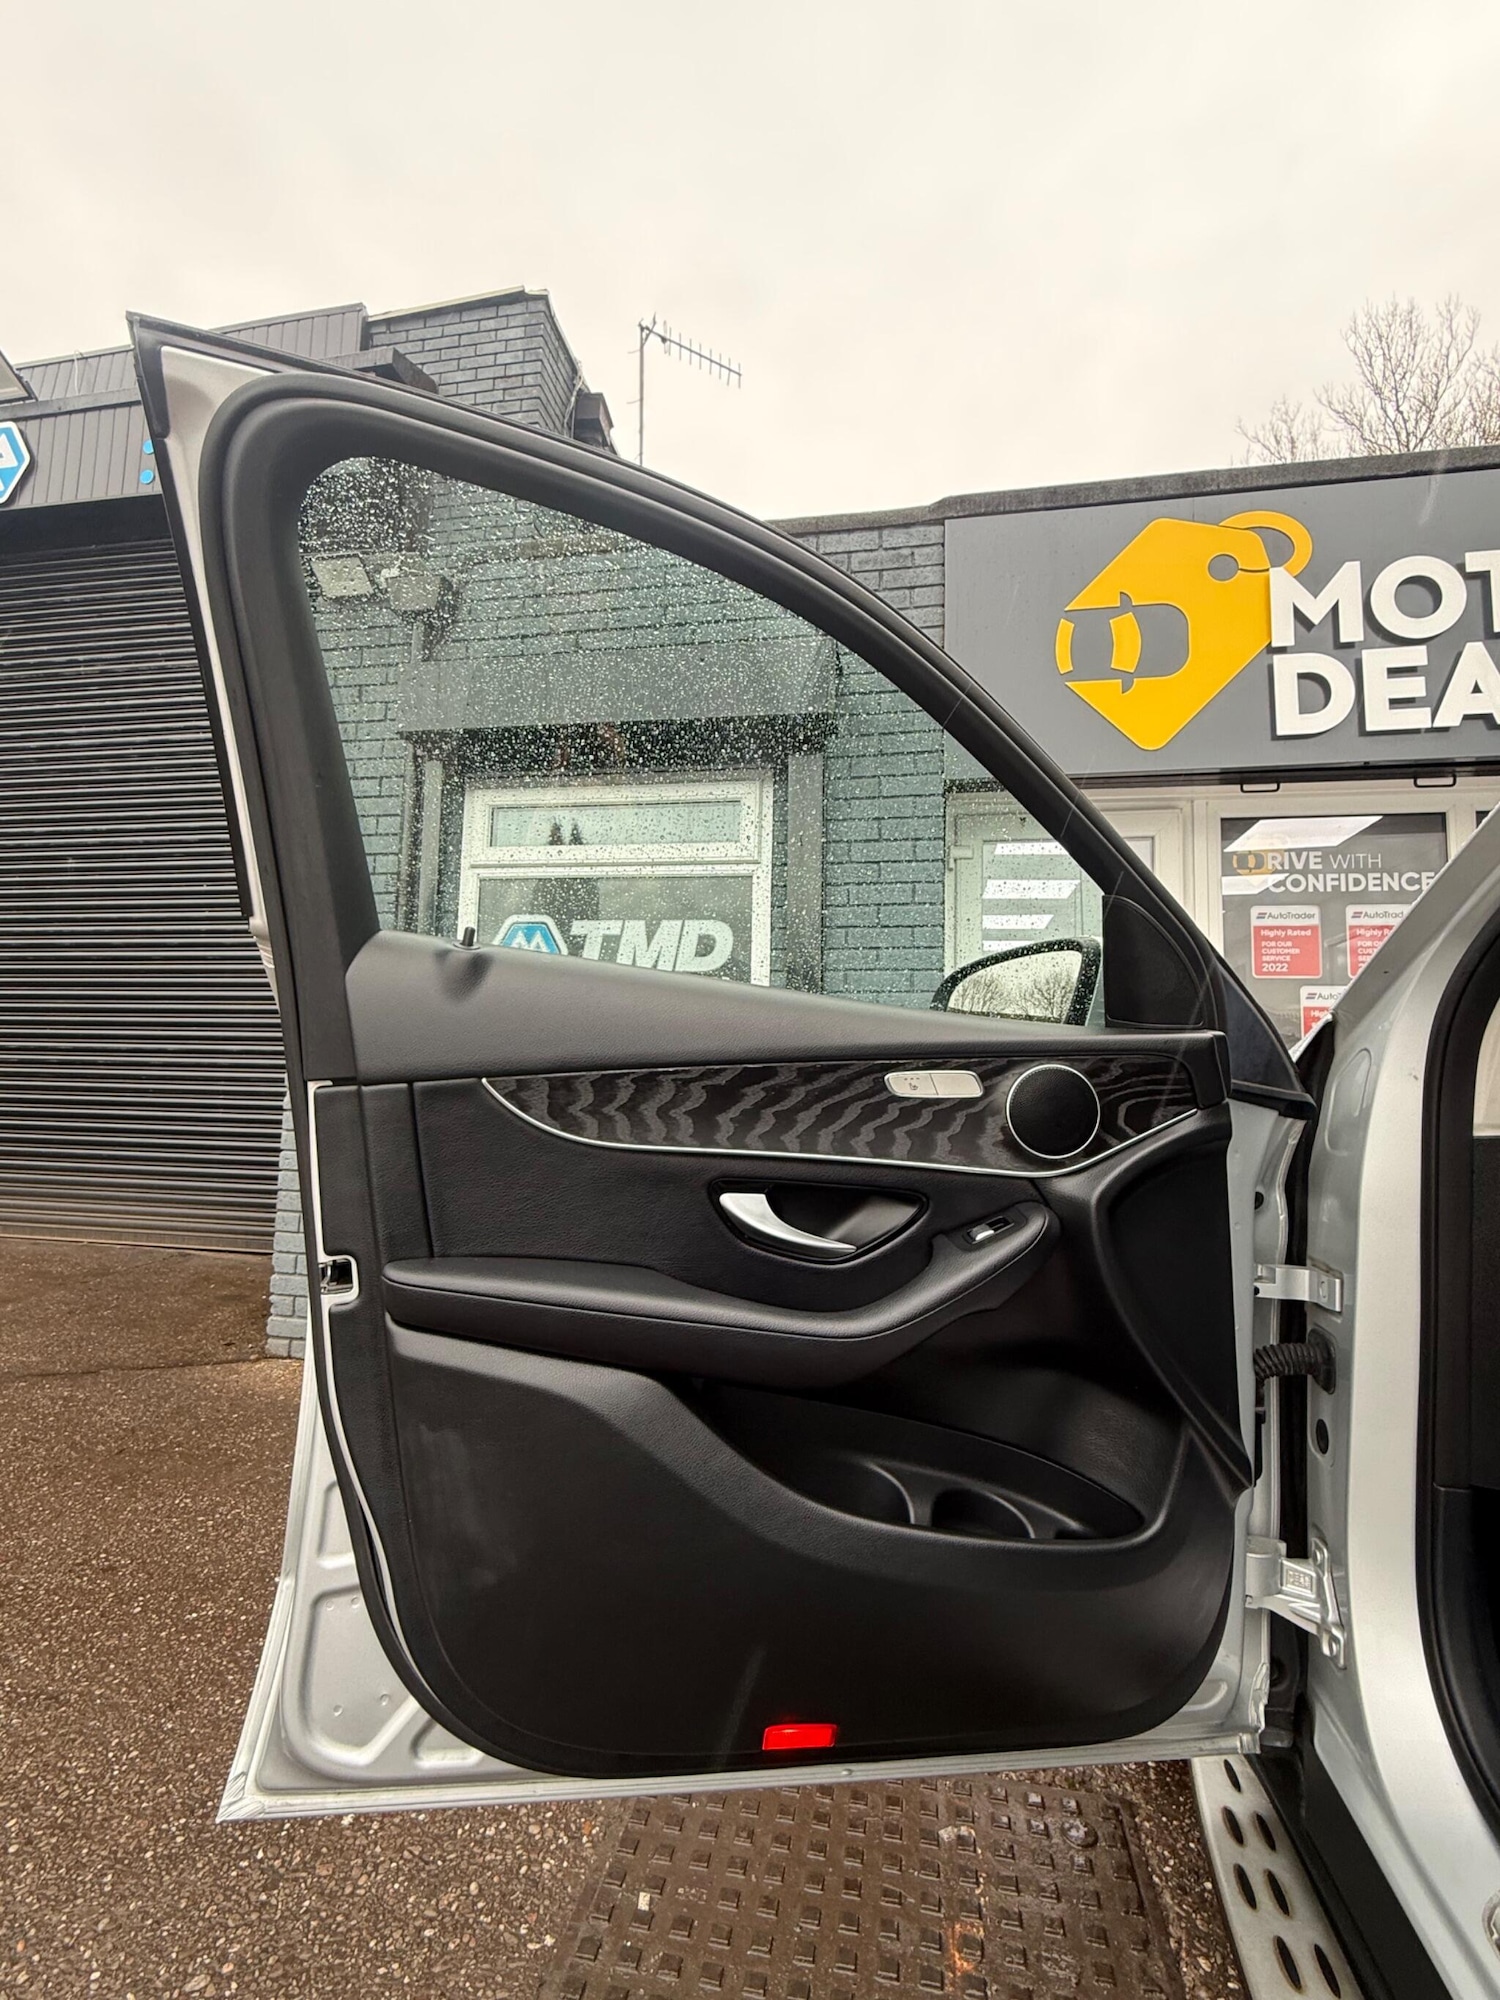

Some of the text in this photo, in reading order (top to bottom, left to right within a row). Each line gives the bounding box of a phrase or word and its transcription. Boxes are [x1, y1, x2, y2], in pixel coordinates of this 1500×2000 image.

[1272, 641, 1500, 736] DEA
[1329, 853, 1382, 869] WITH
[1267, 871, 1436, 893] CONFIDENCE
[1266, 911, 1316, 920] AutoTrader
[1362, 911, 1404, 919] AutoTrad
[1260, 929, 1312, 938] Highly Rated
[1356, 928, 1383, 938] Highly
[569, 919, 735, 972] TMD
[1262, 963, 1289, 972] 2022
